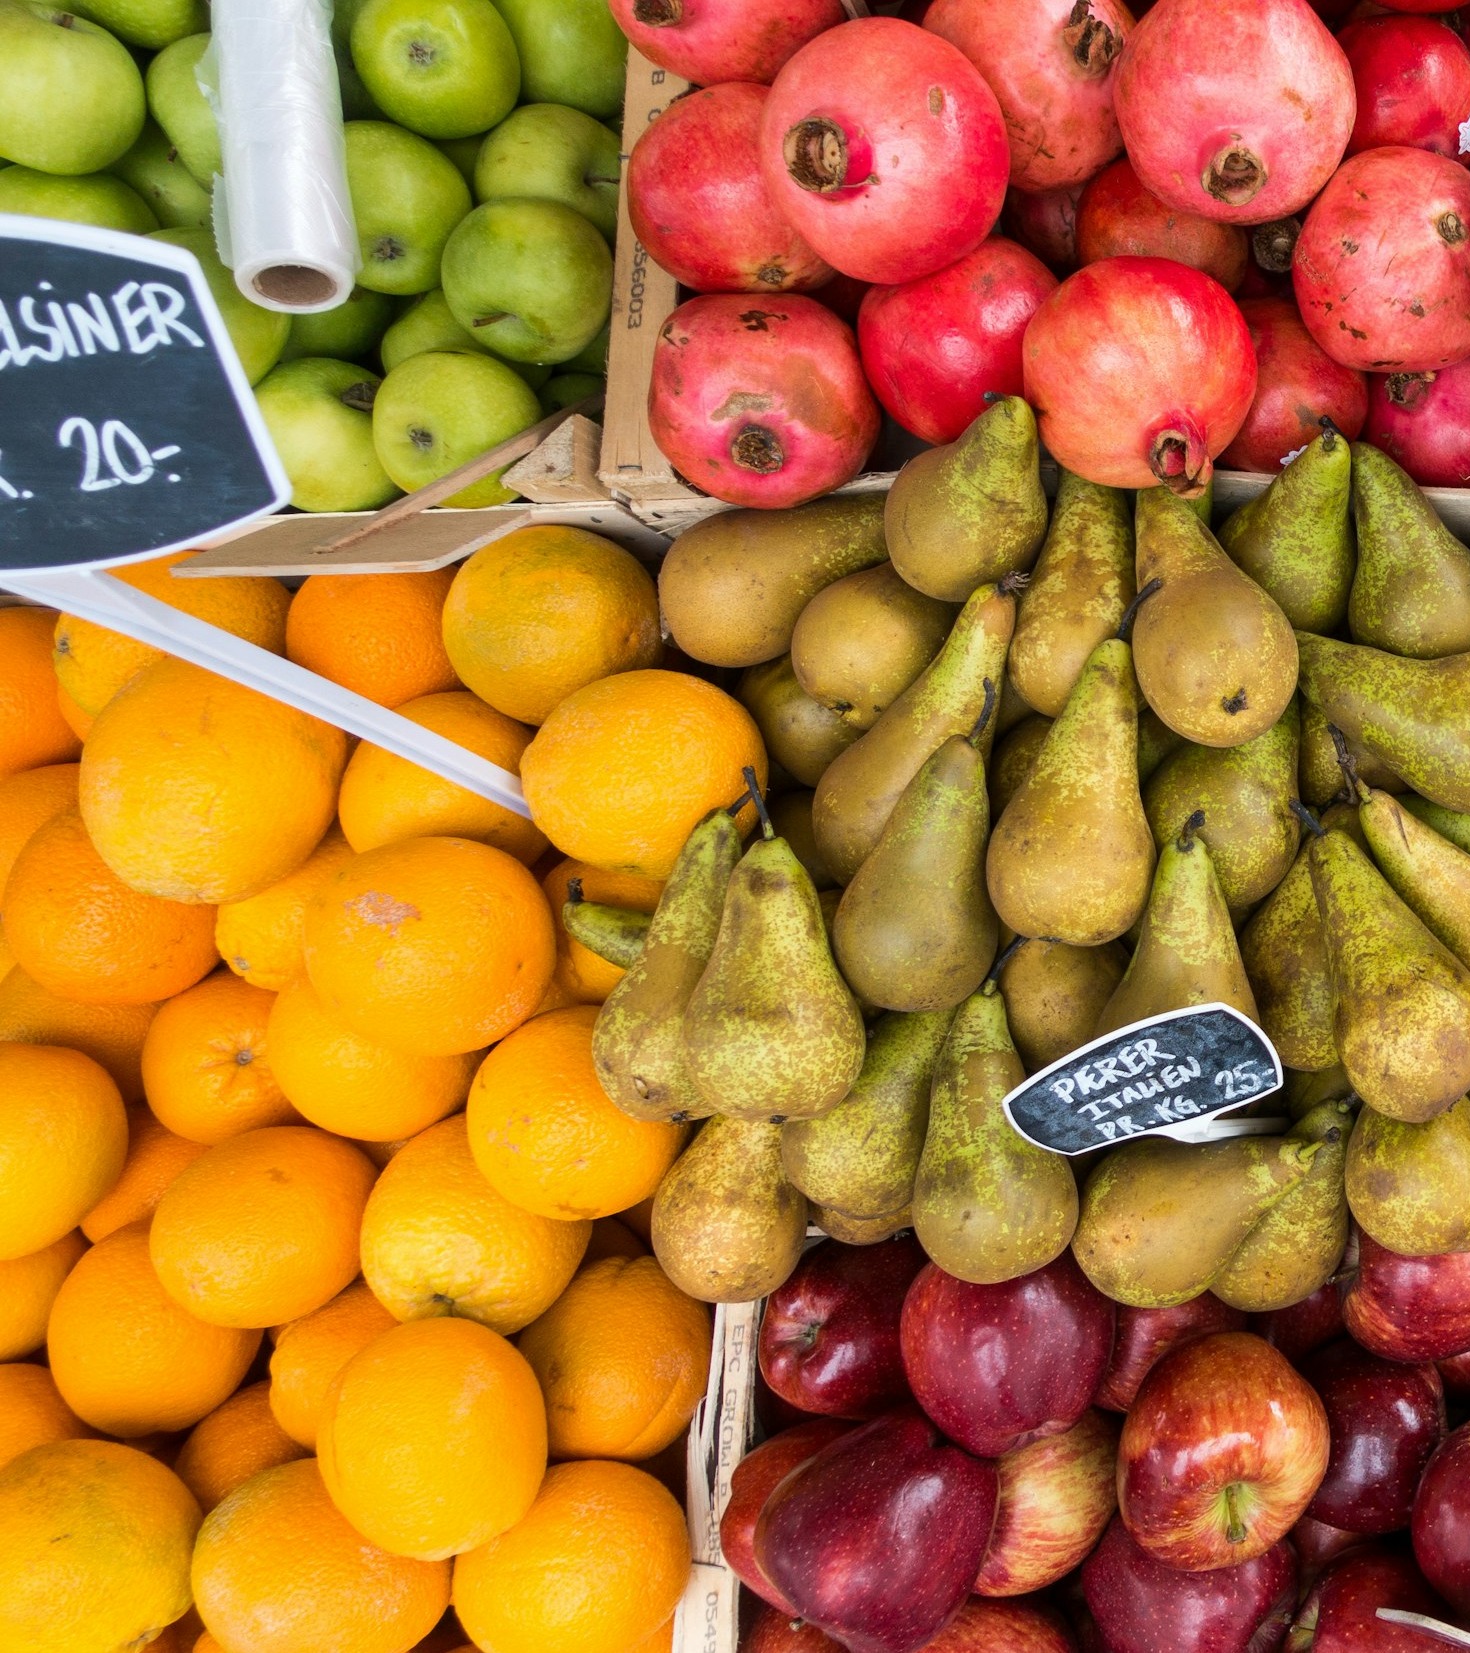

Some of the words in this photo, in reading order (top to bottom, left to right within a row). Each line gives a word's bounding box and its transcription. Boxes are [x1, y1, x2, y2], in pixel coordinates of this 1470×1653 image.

[0, 280, 205, 372] LSINER
[1077, 1055, 1202, 1121] ITALIEN
[727, 1323, 746, 1374] EPC
